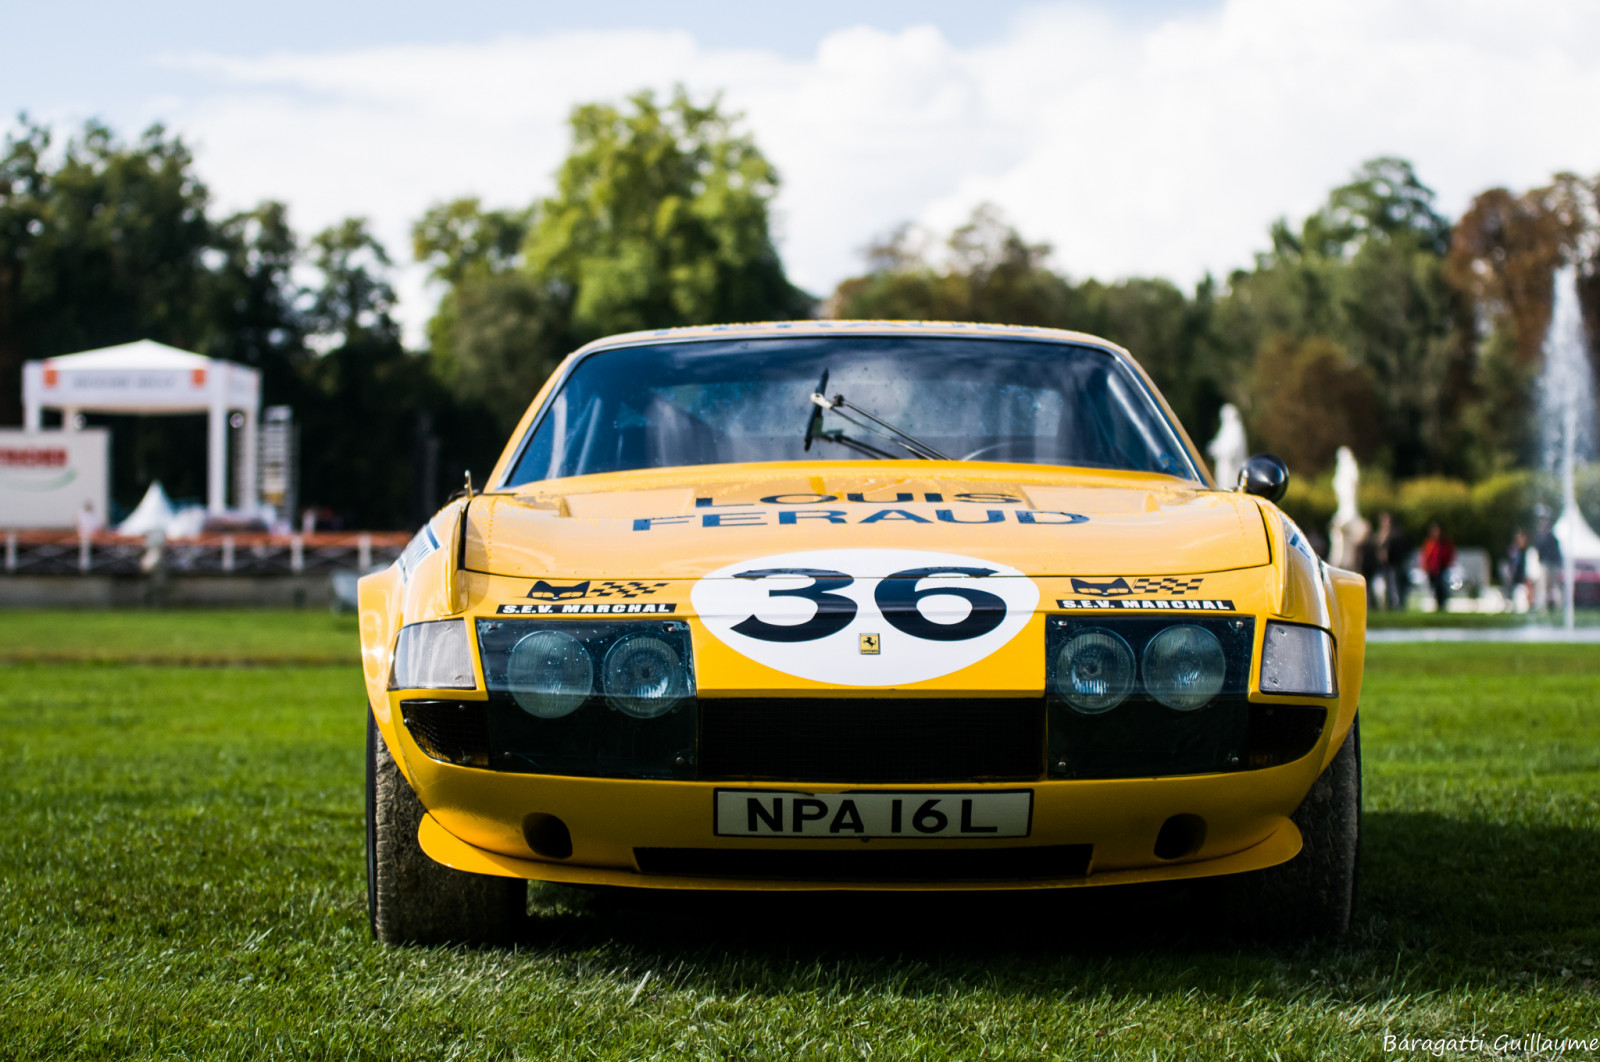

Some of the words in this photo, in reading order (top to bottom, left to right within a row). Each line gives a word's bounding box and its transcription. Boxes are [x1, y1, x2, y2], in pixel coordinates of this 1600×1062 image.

[695, 493, 1022, 508] LOUIS
[633, 509, 1090, 531] FERAUD
[502, 604, 553, 614] S.E.V.
[561, 603, 670, 613] MARCHAL
[729, 566, 1007, 643] 36
[1062, 599, 1115, 609] S.E.V.
[1120, 599, 1230, 610] MARCHAL
[747, 798, 864, 833] NPA
[891, 799, 998, 833] 16L
